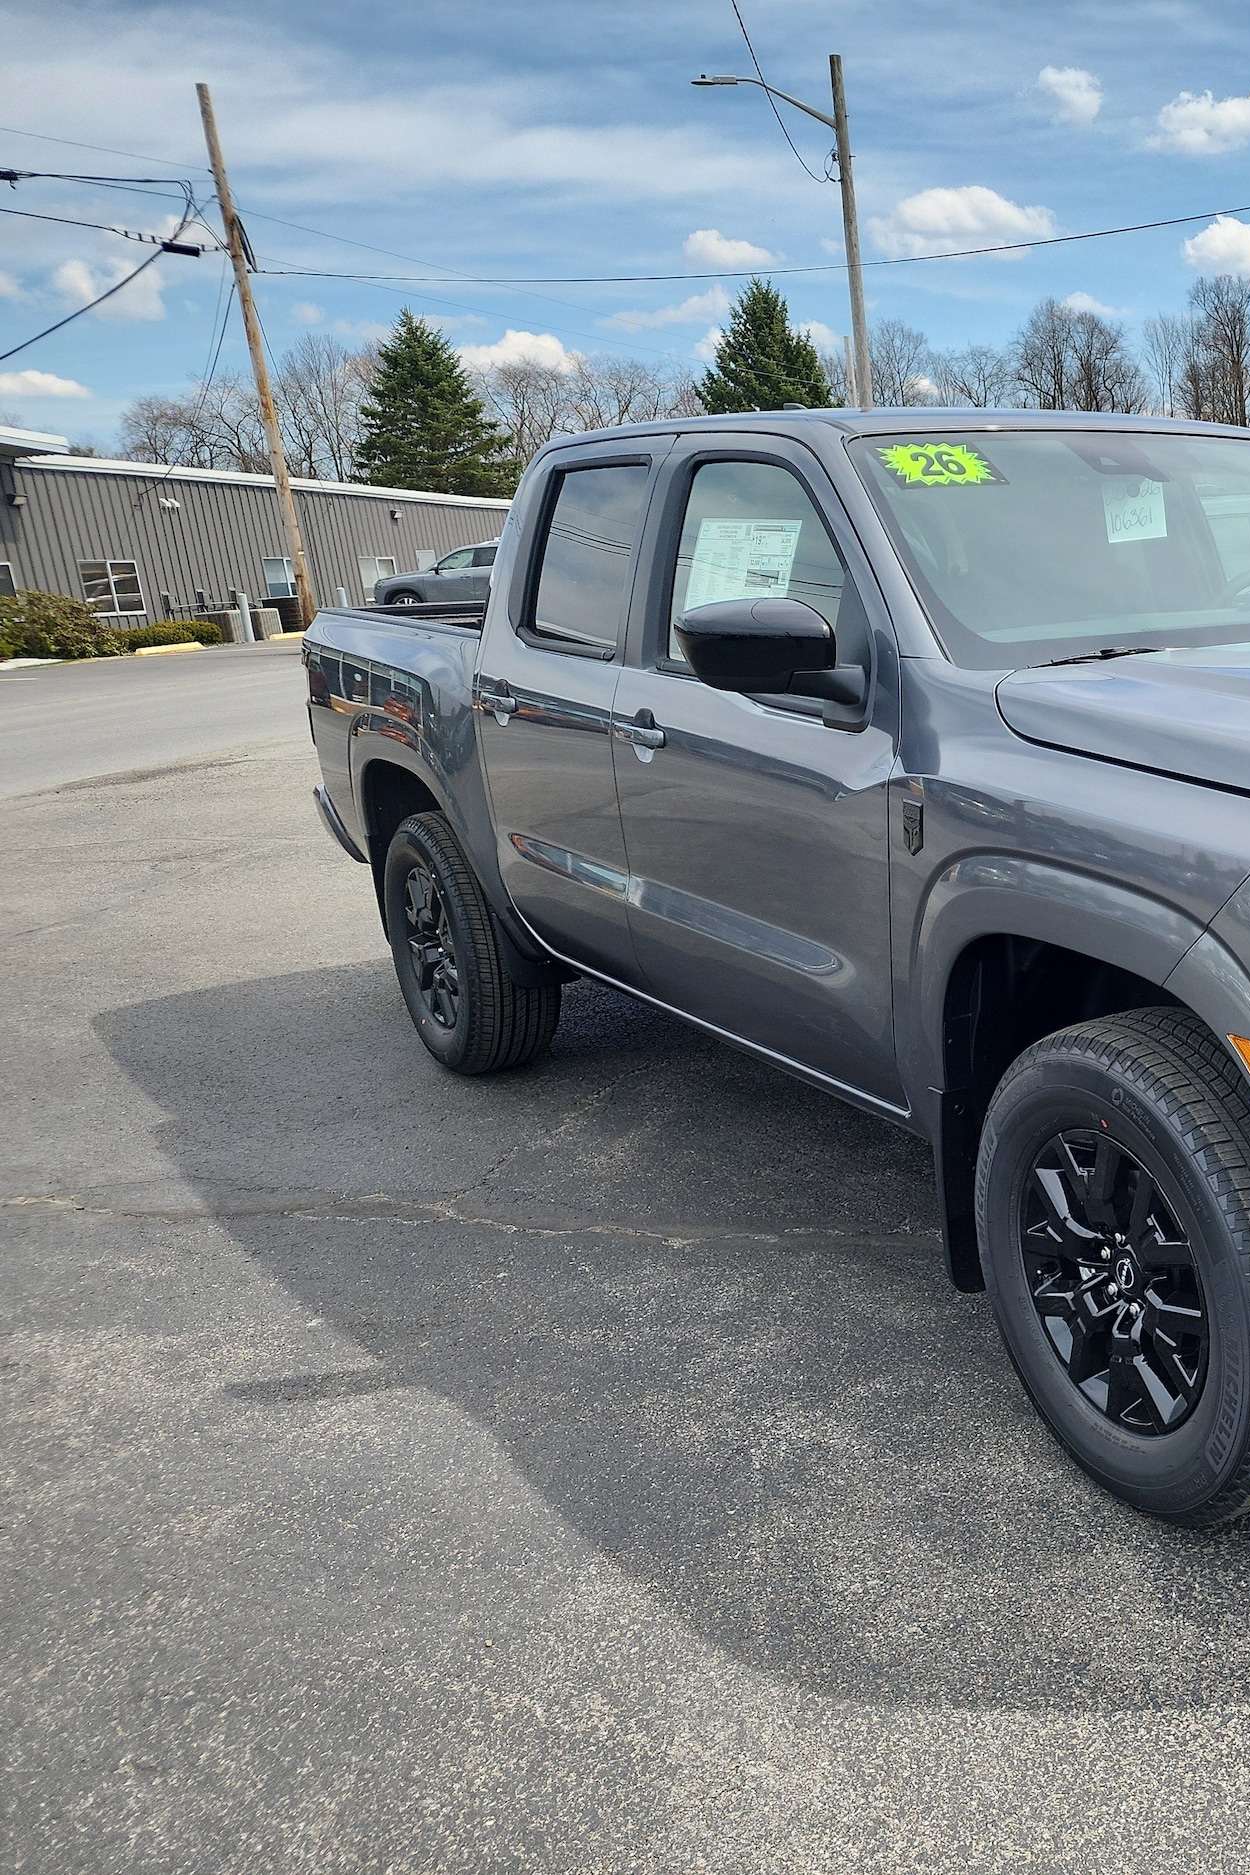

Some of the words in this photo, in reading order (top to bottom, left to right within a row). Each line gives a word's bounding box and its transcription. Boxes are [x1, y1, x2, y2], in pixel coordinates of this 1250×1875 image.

[909, 450, 967, 477] 26
[1109, 506, 1153, 535] 106361
[1208, 1334, 1240, 1467] MICHELIN
